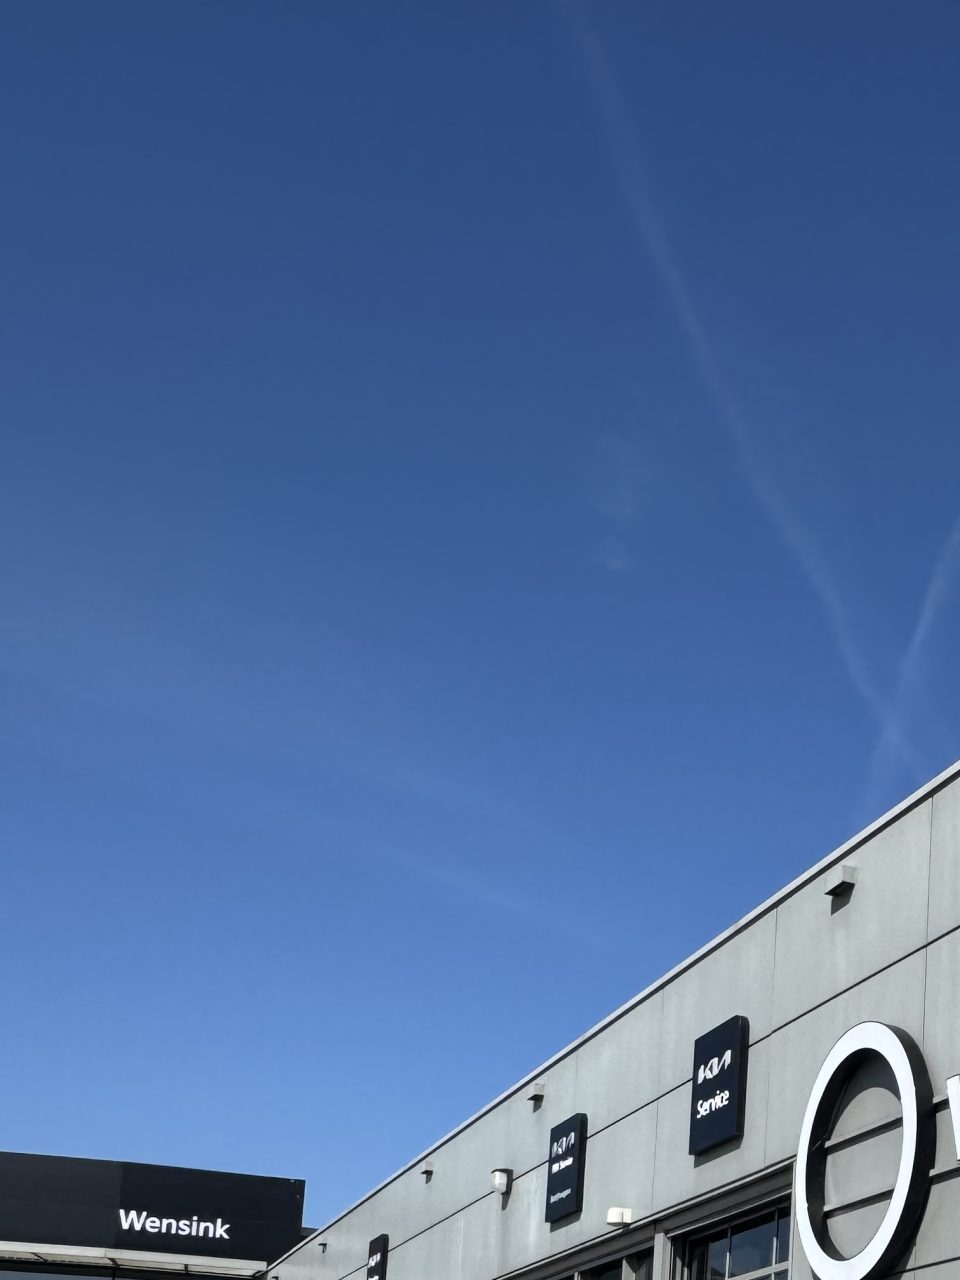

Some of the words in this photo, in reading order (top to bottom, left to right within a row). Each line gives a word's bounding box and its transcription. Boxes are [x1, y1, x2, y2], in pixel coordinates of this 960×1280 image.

[698, 1049, 732, 1085] KIA
[697, 1090, 730, 1118] Service
[119, 1208, 231, 1239] Wensink
